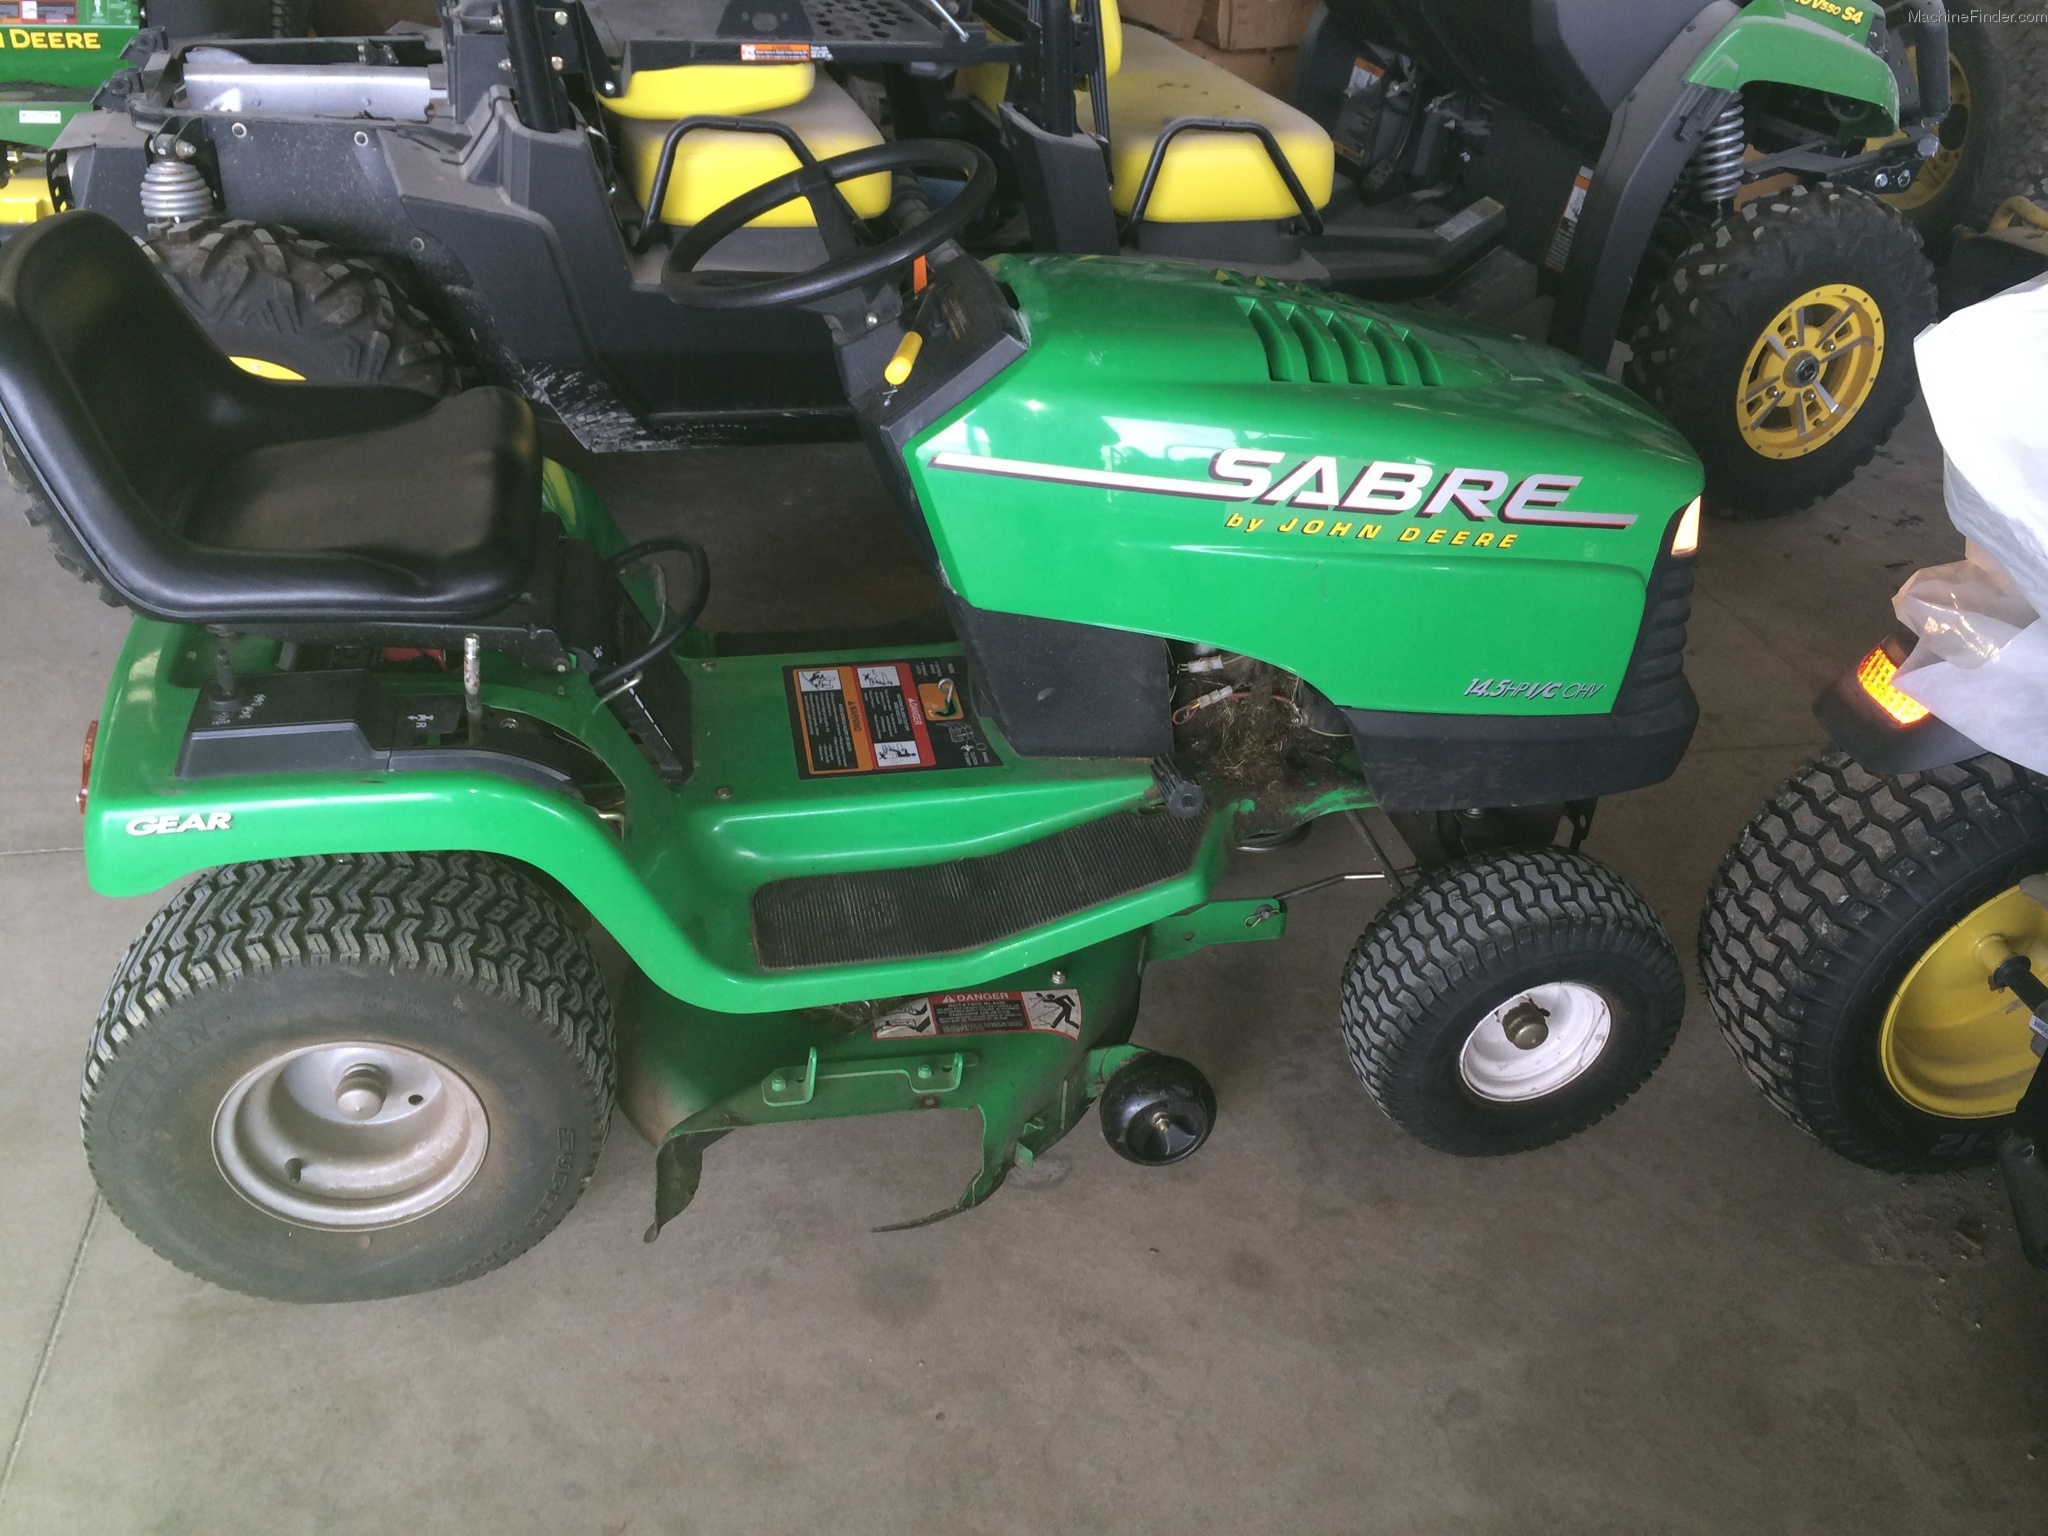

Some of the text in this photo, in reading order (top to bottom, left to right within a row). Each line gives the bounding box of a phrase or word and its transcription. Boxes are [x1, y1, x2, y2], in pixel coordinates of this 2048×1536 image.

[1841, 6, 1865, 25] S4
[9, 29, 101, 49] DEERE
[1207, 447, 1590, 525] SABRE
[1224, 512, 1520, 549] by JOHN DEERE
[125, 812, 232, 836] GEAR
[956, 992, 1009, 1002] DANGER
